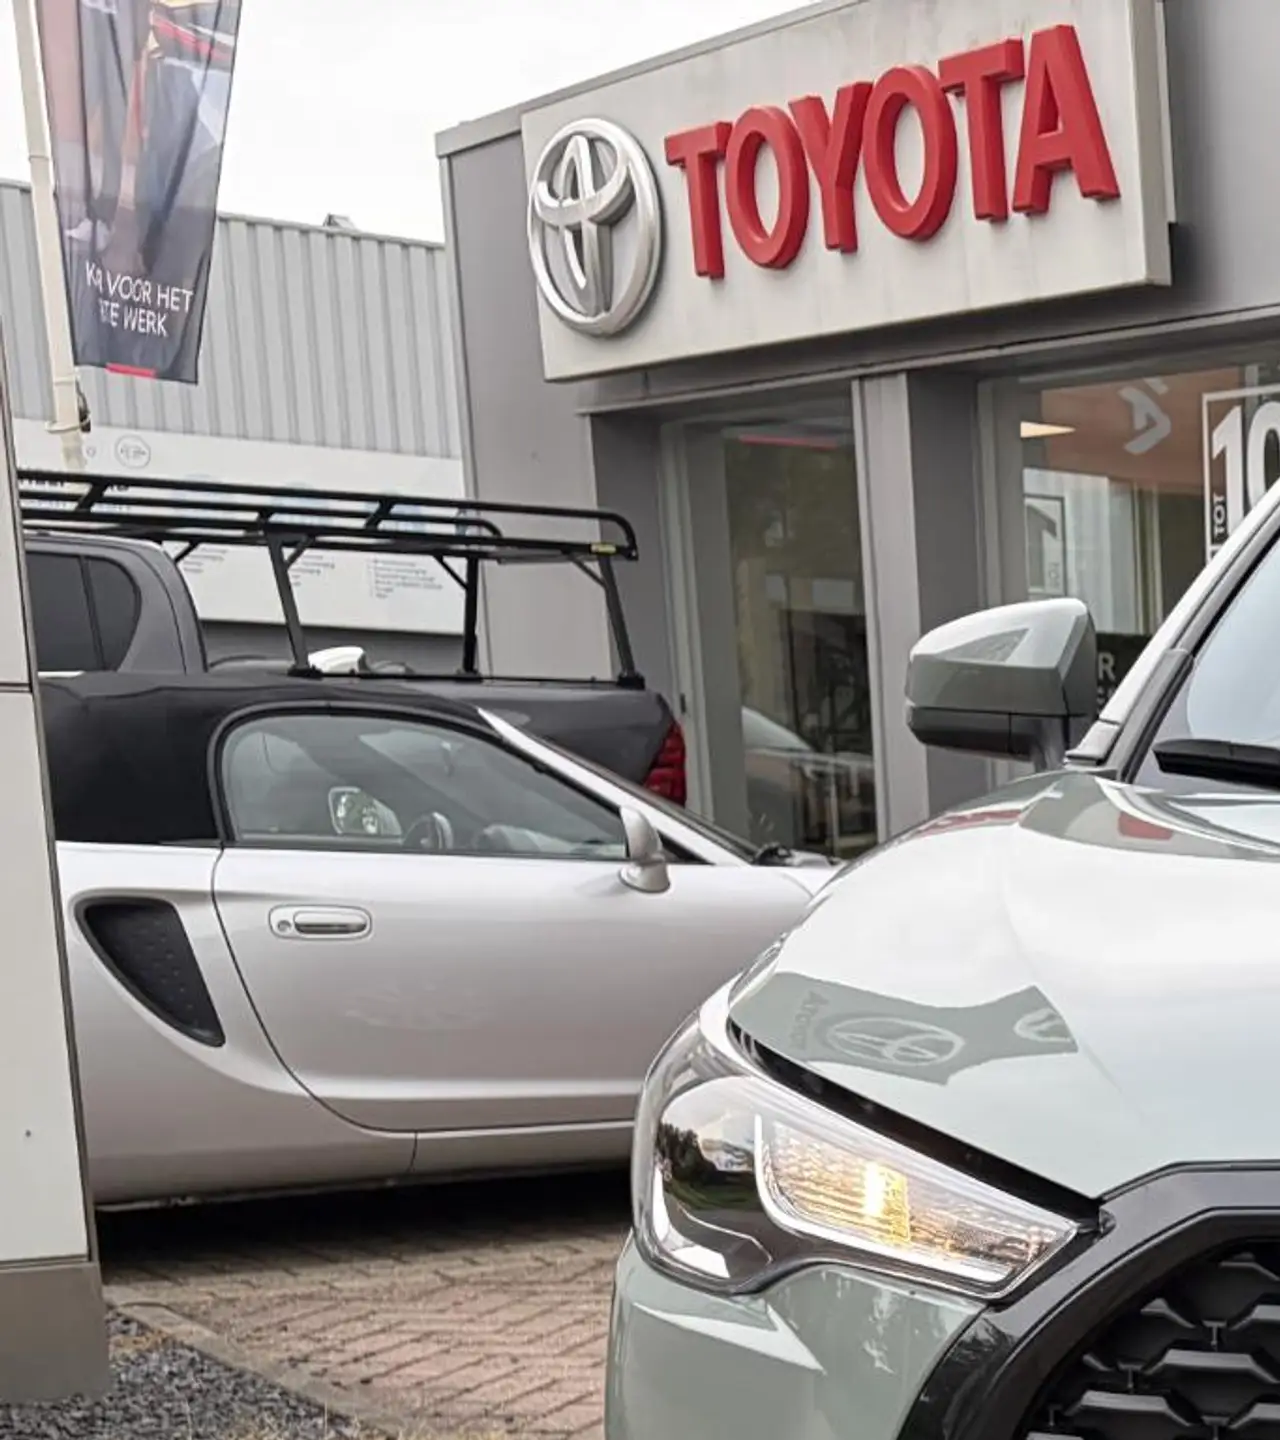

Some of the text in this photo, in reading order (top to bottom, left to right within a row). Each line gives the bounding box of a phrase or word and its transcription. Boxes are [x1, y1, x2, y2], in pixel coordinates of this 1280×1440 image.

[664, 24, 1121, 279] TOYOTA
[106, 269, 152, 306] VOOR
[156, 283, 194, 313] HET
[123, 305, 168, 338] WERK
[1212, 493, 1226, 534] TOT
